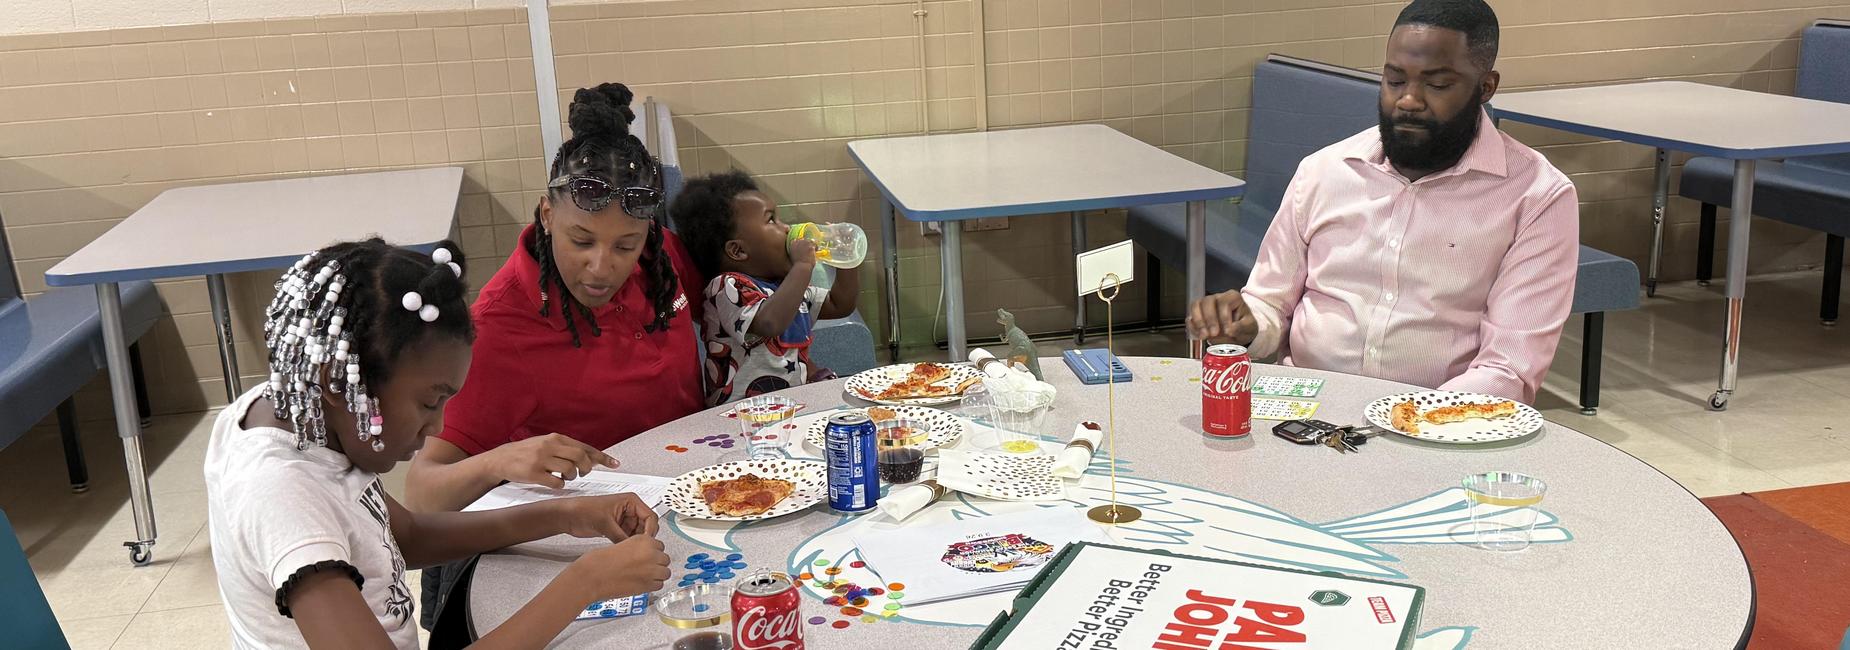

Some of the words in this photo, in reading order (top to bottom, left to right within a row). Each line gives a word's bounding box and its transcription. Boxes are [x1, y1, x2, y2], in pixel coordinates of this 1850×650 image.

[1085, 579, 1133, 620] Better
[1132, 563, 1172, 605] Better
[1089, 606, 1144, 650] Ingred
[1217, 600, 1307, 650] PA
